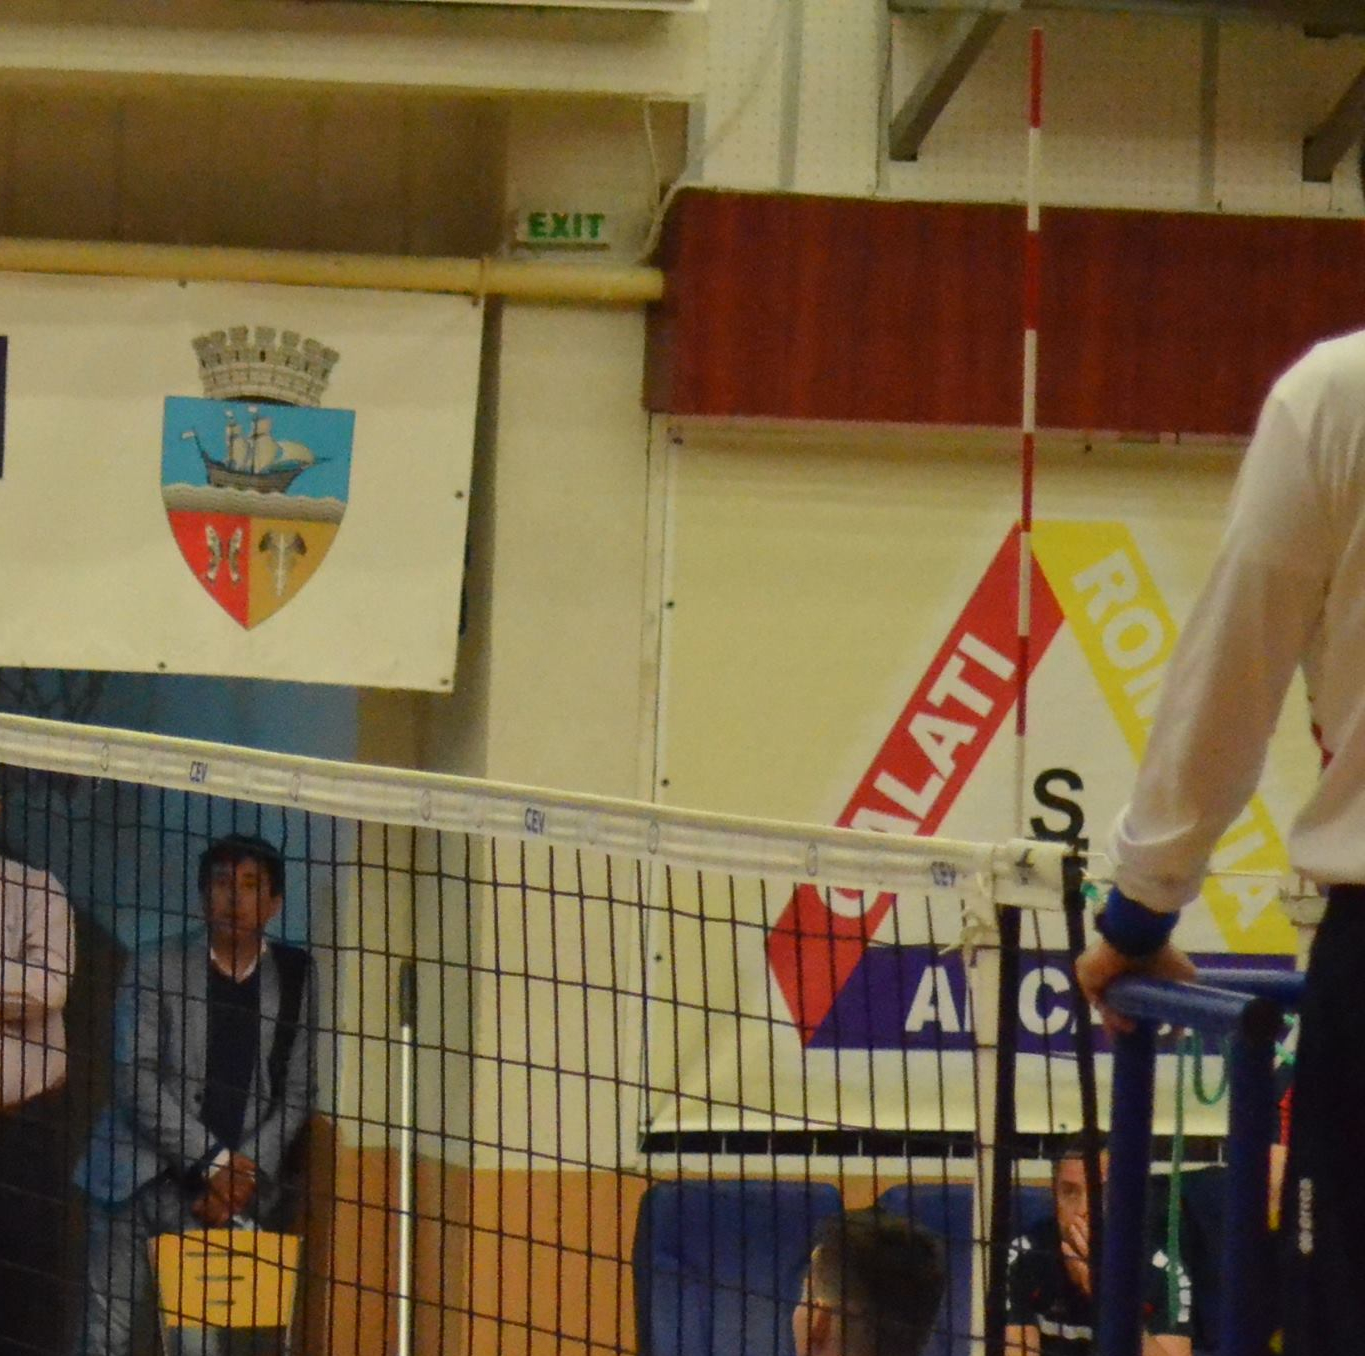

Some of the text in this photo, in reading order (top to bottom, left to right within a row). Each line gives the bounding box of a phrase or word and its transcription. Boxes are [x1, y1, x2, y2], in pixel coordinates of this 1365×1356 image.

[527, 211, 606, 240] EXIT
[189, 760, 210, 784] CEV
[524, 806, 546, 836] CEV
